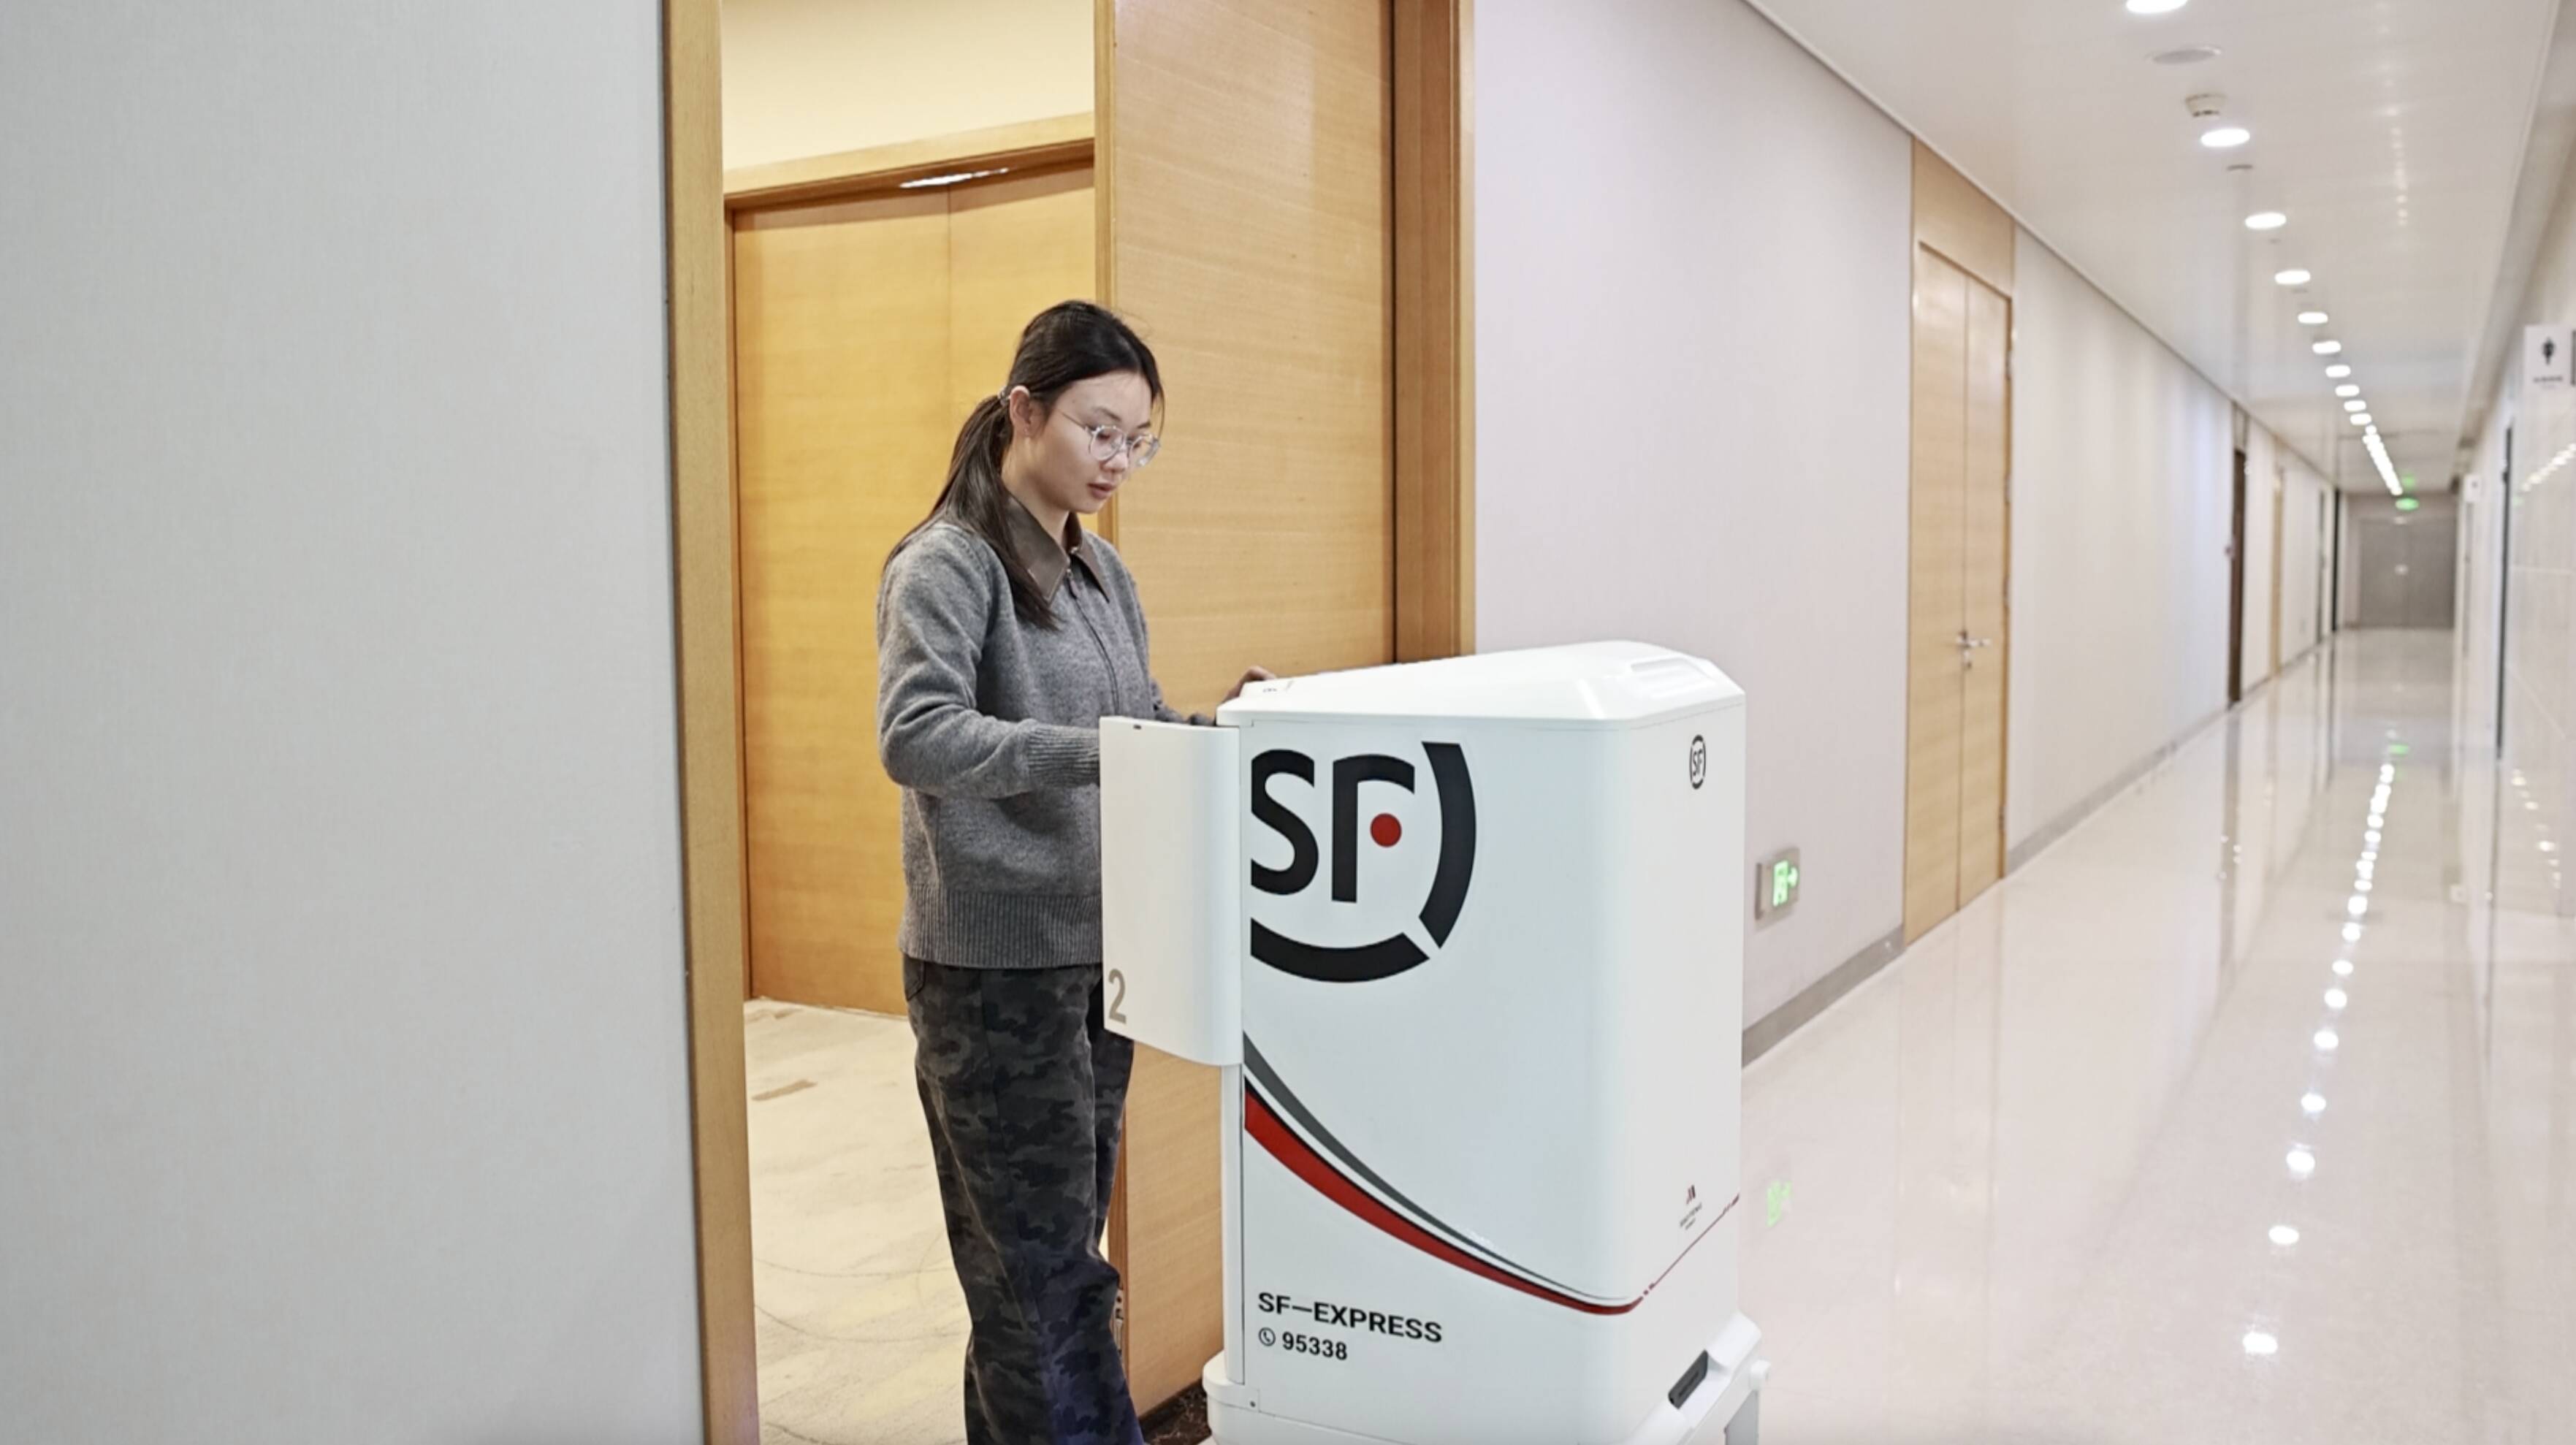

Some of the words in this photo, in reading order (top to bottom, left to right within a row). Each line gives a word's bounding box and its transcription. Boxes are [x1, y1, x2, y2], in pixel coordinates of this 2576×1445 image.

[1250, 748, 1415, 904] SF
[1108, 968, 1127, 1025] 2
[1281, 1330, 1348, 1361] 95338
